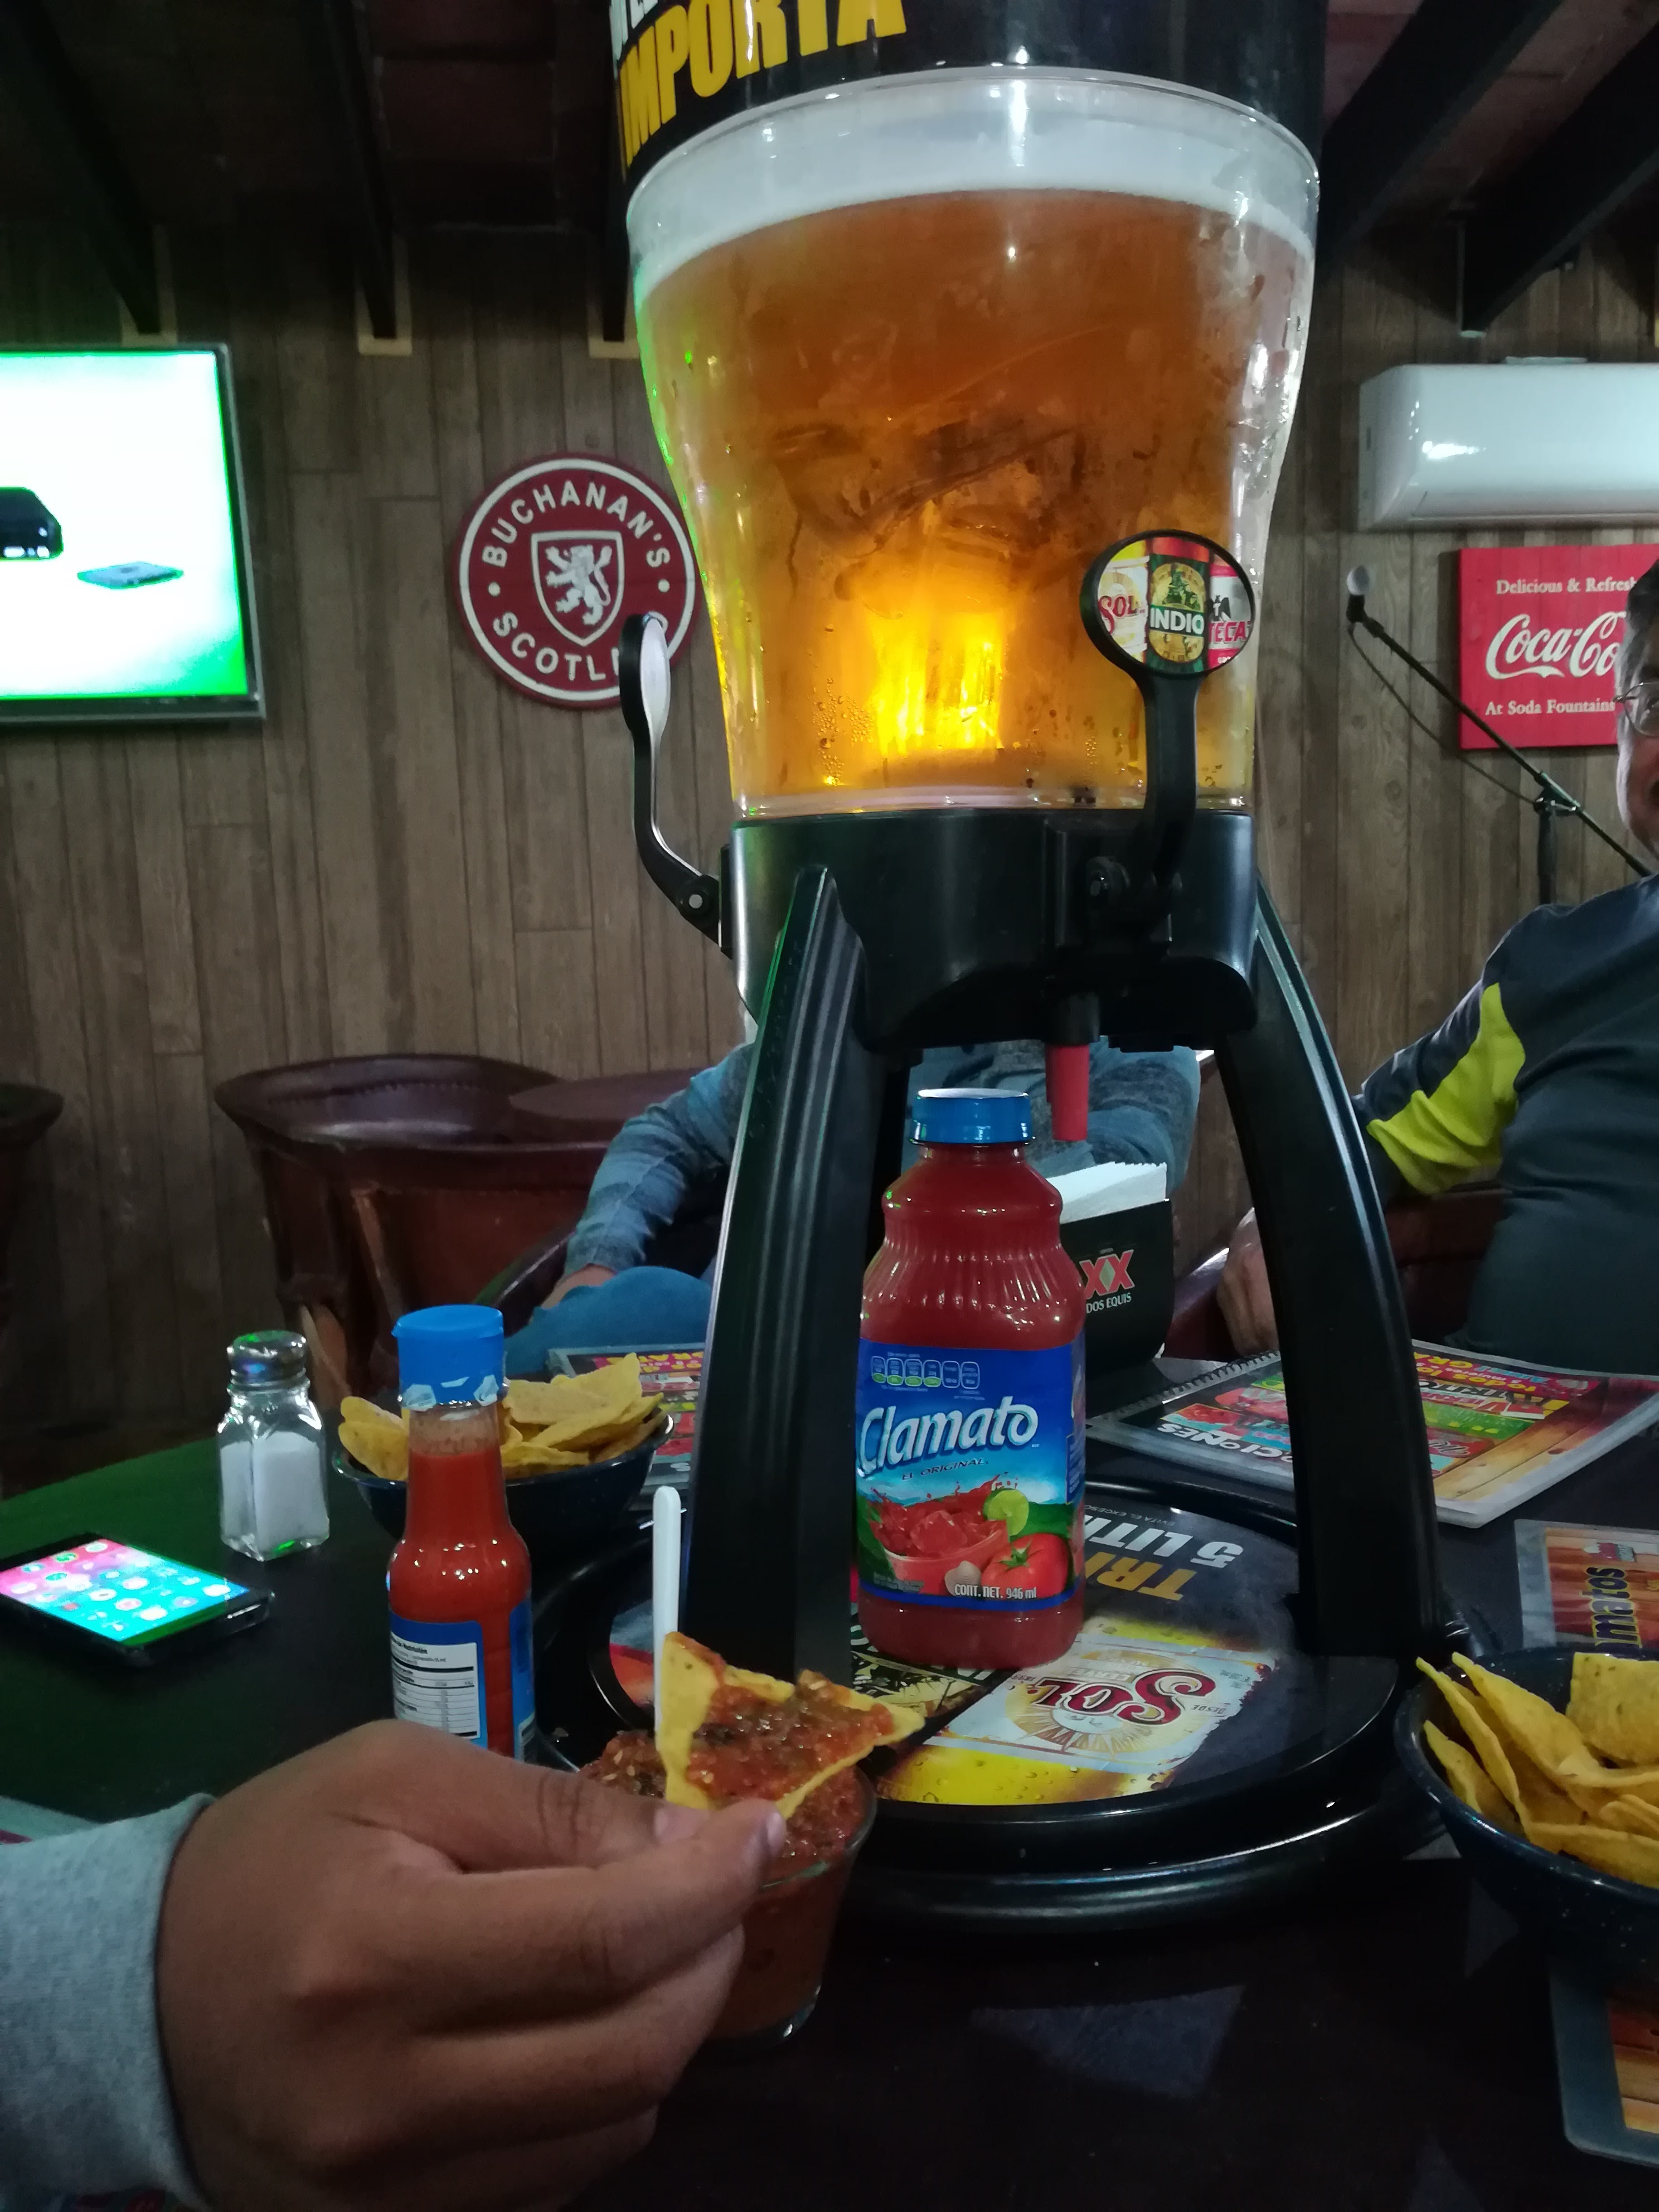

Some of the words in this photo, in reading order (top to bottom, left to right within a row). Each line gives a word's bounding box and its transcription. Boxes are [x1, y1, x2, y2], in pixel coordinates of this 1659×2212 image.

[482, 480, 671, 567] BUCHANAN'S
[1496, 579, 1562, 594] Delicious
[1568, 578, 1580, 593] &
[1150, 608, 1205, 635] INDIO
[1486, 701, 1503, 715] At
[1508, 700, 1541, 715] Soda
[1546, 698, 1616, 714] Fountains
[1086, 1300, 1105, 1313] DOS
[1106, 1292, 1132, 1308] EQUIS
[857, 1396, 1038, 1477] Clamato
[902, 1472, 914, 1481] EL
[1190, 1541, 1244, 1568] 5
[954, 1584, 981, 1597] CONT.
[1006, 1588, 1023, 1599] 946
[1025, 1587, 1037, 1599] ml
[1580, 1566, 1642, 1647] matos
[1031, 1668, 1216, 1726] SOL
[1191, 1704, 1226, 1715] DESDE
